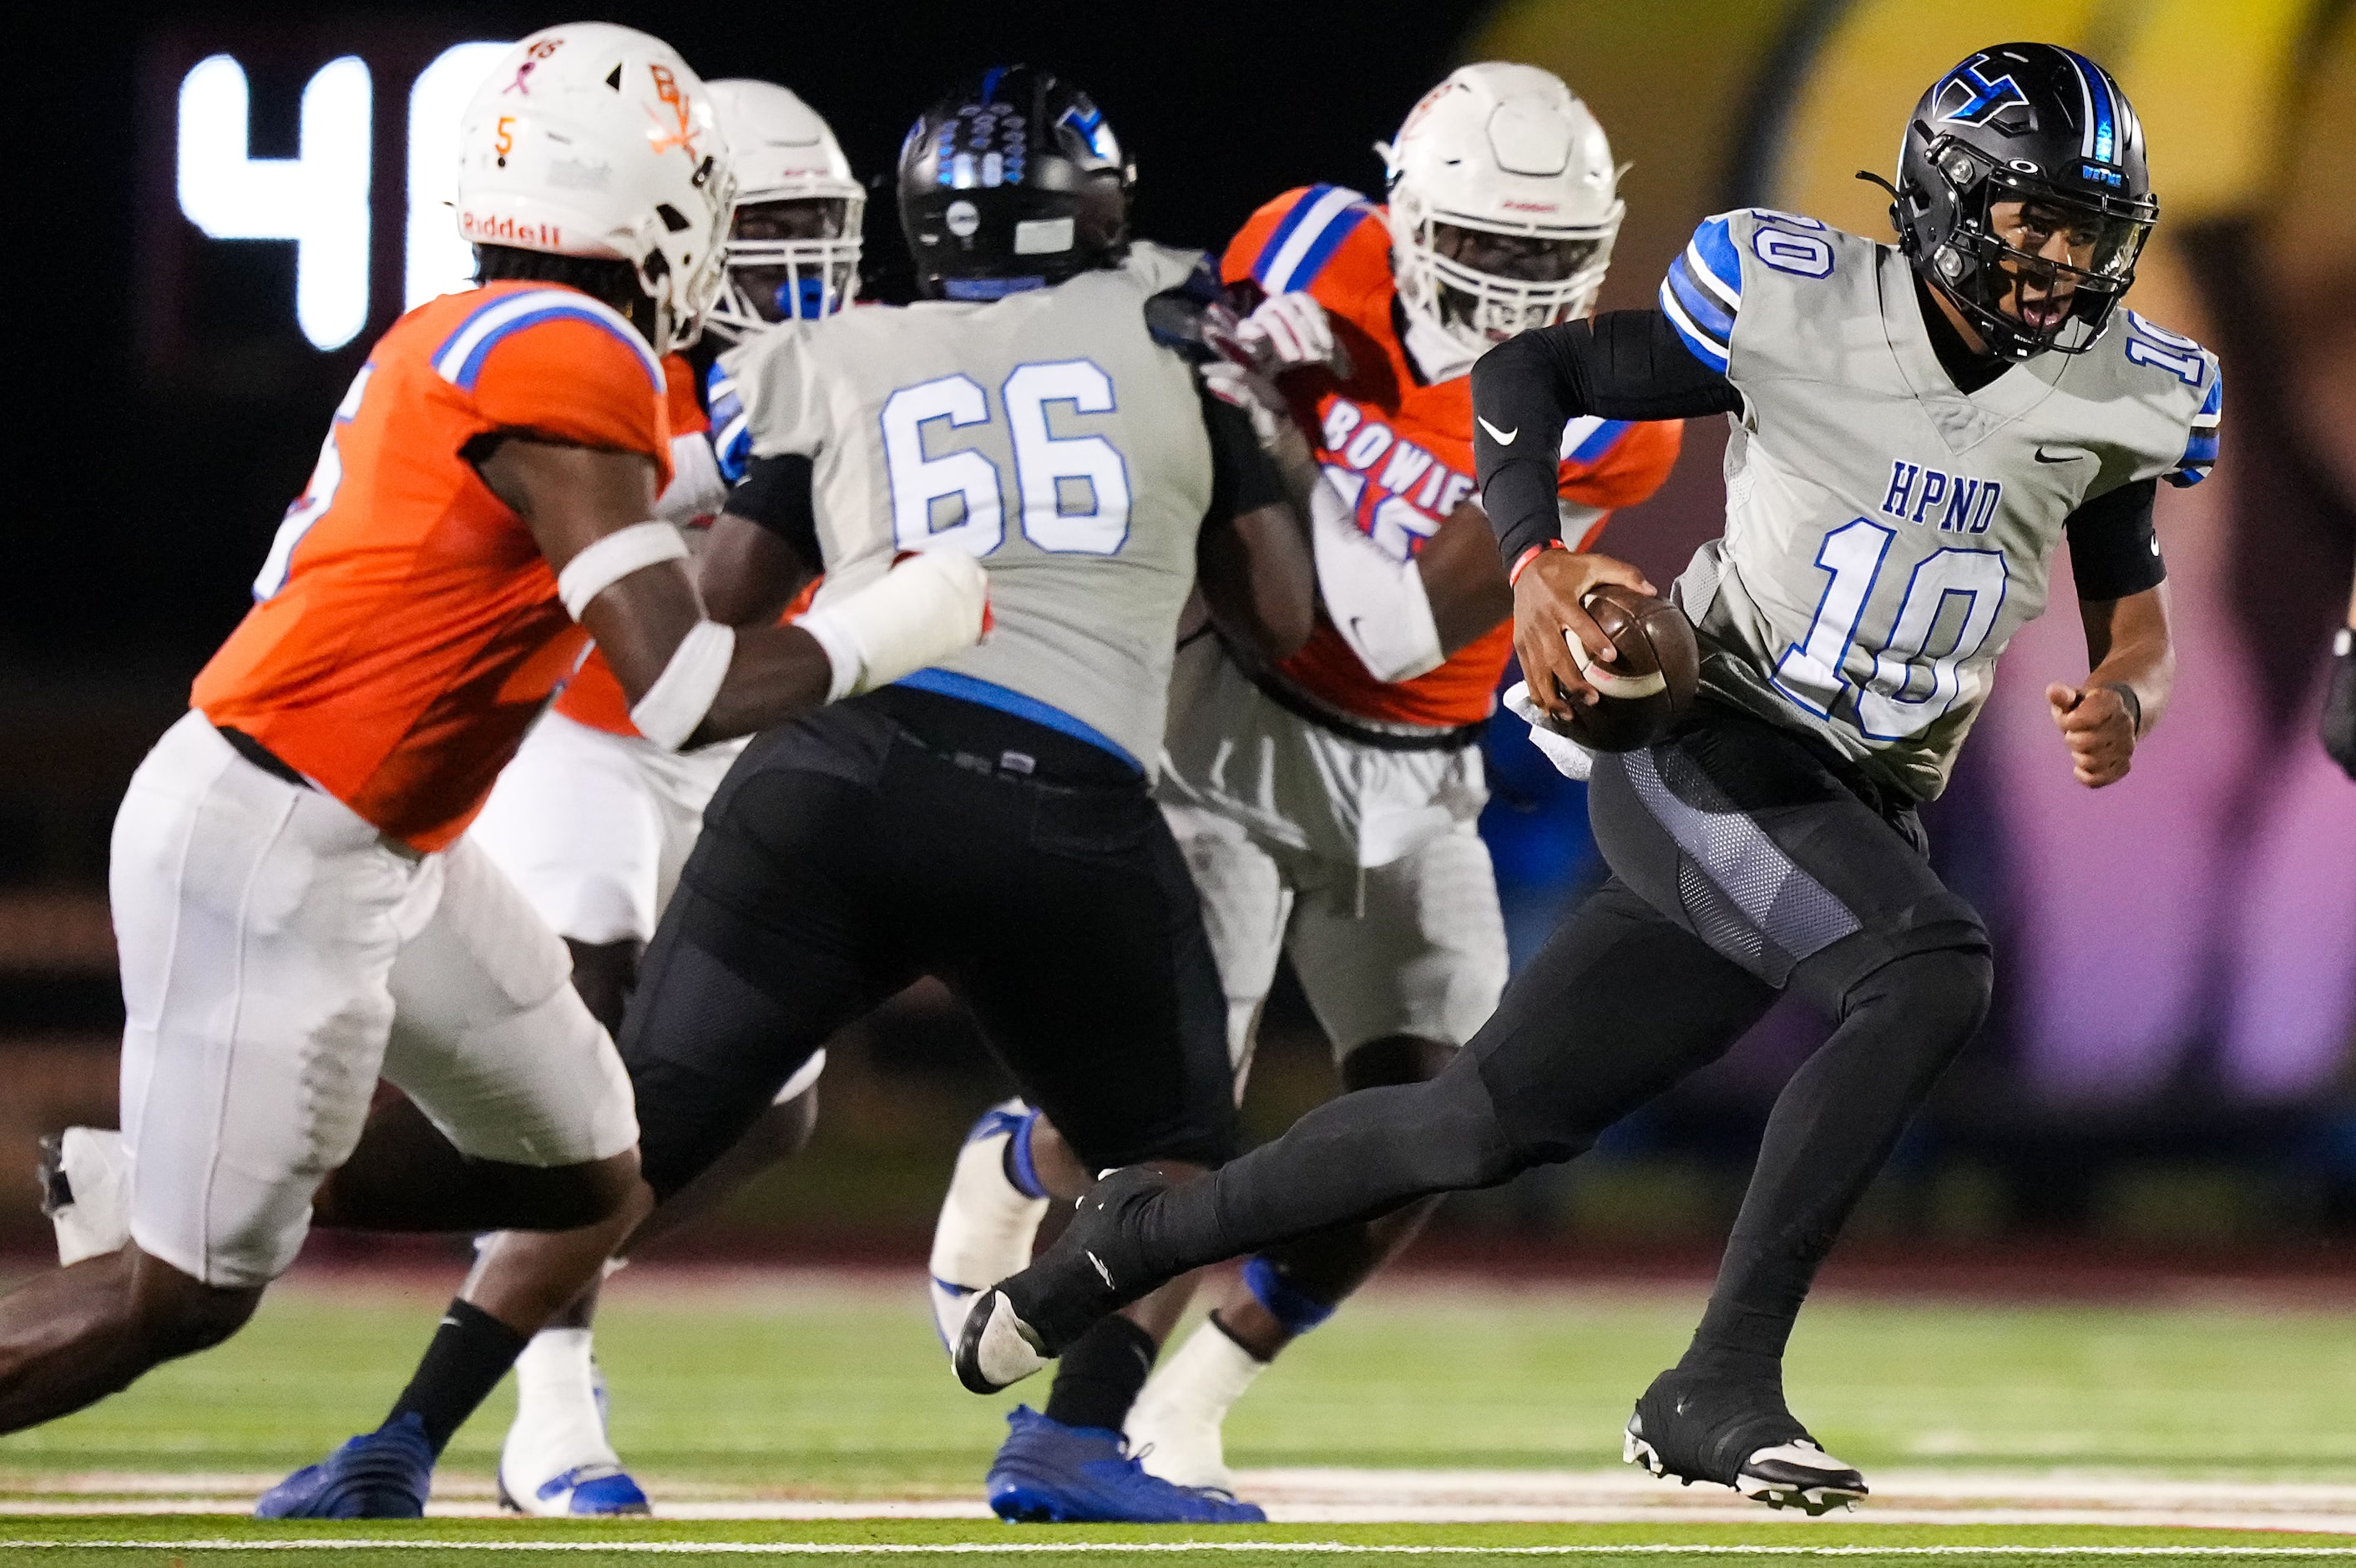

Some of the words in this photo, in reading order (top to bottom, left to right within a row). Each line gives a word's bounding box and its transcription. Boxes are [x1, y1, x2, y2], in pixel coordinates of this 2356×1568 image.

[494, 116, 517, 155] 5
[463, 211, 561, 250] Riddell
[2125, 308, 2205, 388] 10
[880, 357, 1132, 559] 66
[1878, 458, 2004, 535] HPND
[1769, 517, 2009, 741] 10
